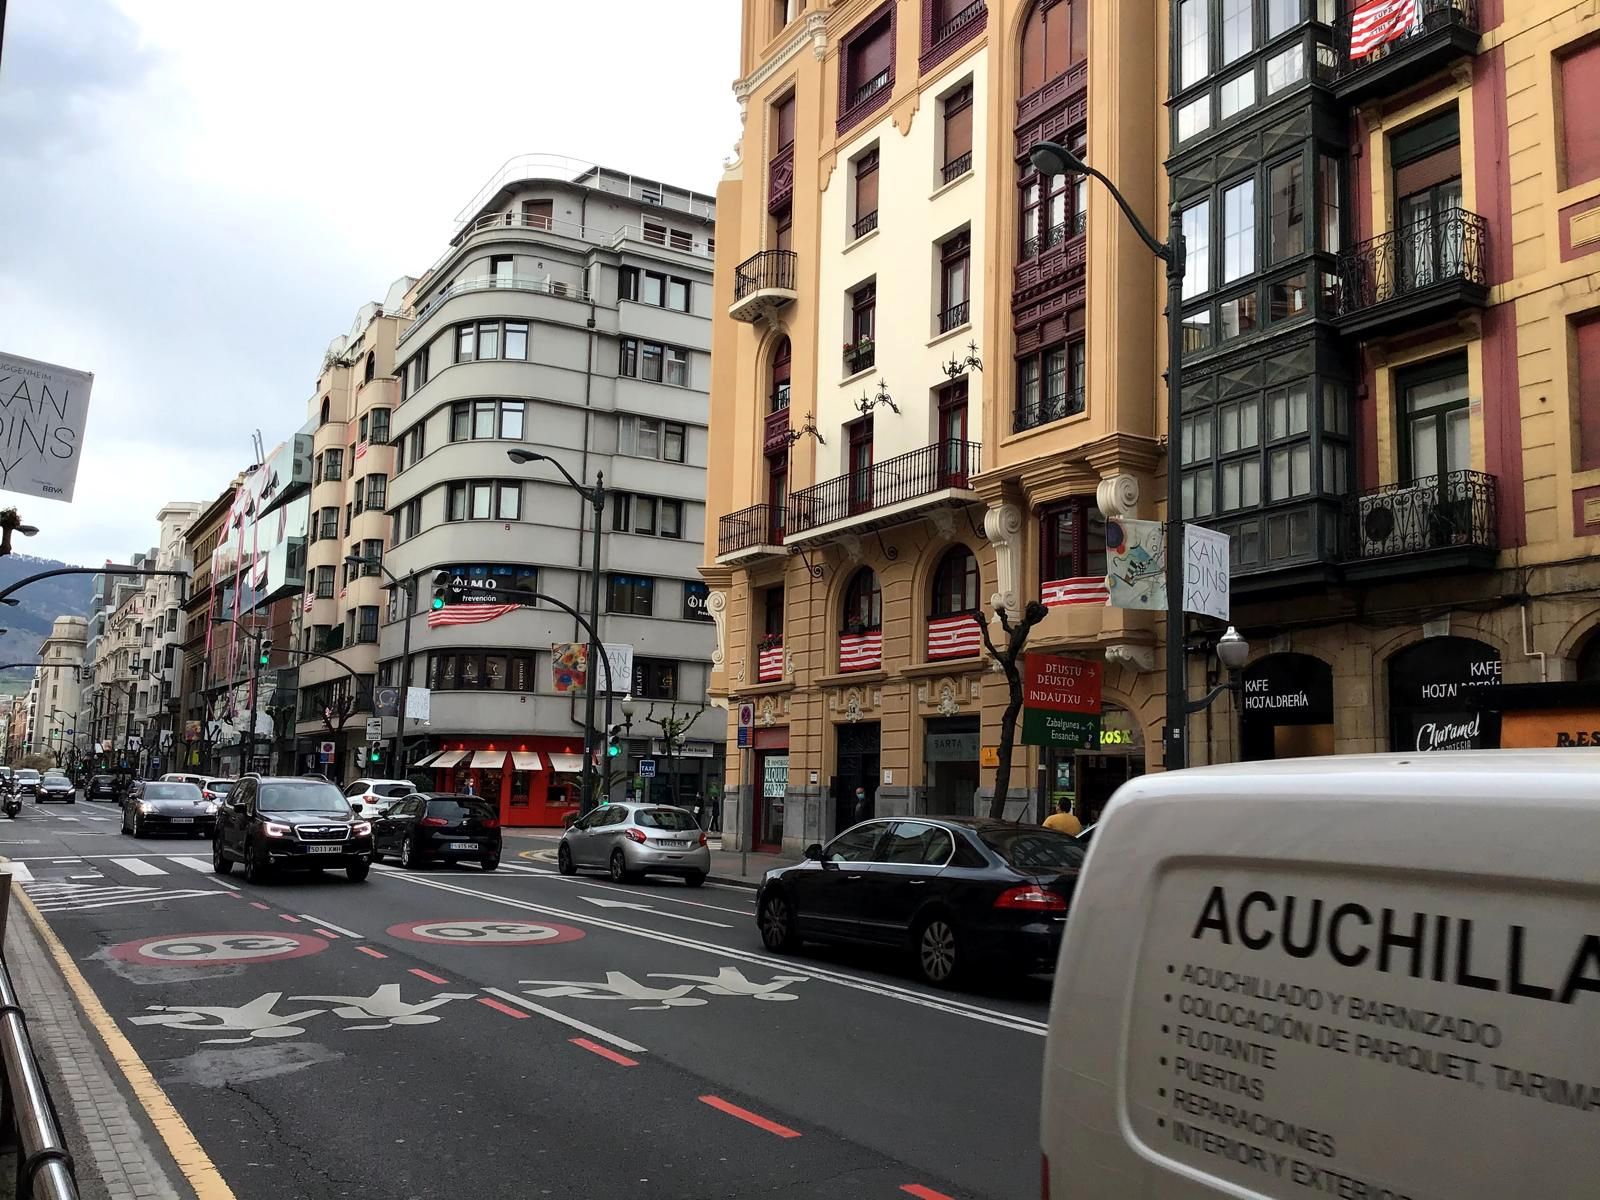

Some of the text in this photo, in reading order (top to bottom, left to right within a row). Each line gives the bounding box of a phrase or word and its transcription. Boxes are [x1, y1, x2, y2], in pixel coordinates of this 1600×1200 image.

[0, 415, 76, 459] INS
[43, 485, 63, 495] BBVA
[1188, 538, 1223, 567] KAN
[1187, 563, 1228, 593] DINS
[462, 594, 497, 603] Prevención
[1186, 587, 1211, 611] KY
[1037, 674, 1075, 687] DEUSTO
[1045, 663, 1082, 677] DEUSTU
[1470, 660, 1502, 677] KAFE
[1030, 690, 1081, 705] INDAUTXU
[1245, 679, 1269, 693] KAFE
[1245, 690, 1309, 709] HOJALDRERÍA
[1046, 717, 1080, 731] Zabalgunea
[1051, 729, 1080, 742] Ensanche
[1416, 711, 1480, 752] Charamel
[1191, 886, 1600, 1004] ACUCHILLA
[1181, 965, 1503, 1049] ACUCHILLADO Y BARNIZADO
[1176, 1024, 1277, 1070] FLOTANTE
[1178, 994, 1313, 1044] COLOCACIÓN
[1316, 1024, 1350, 1053] DE
[1355, 1034, 1486, 1089] PARQUET,
[1174, 1056, 1265, 1101] PUERTAS
[1174, 1088, 1337, 1158] REPARACIONES
[1173, 1119, 1268, 1172] INTERIOR
[1270, 1152, 1288, 1177] Y
